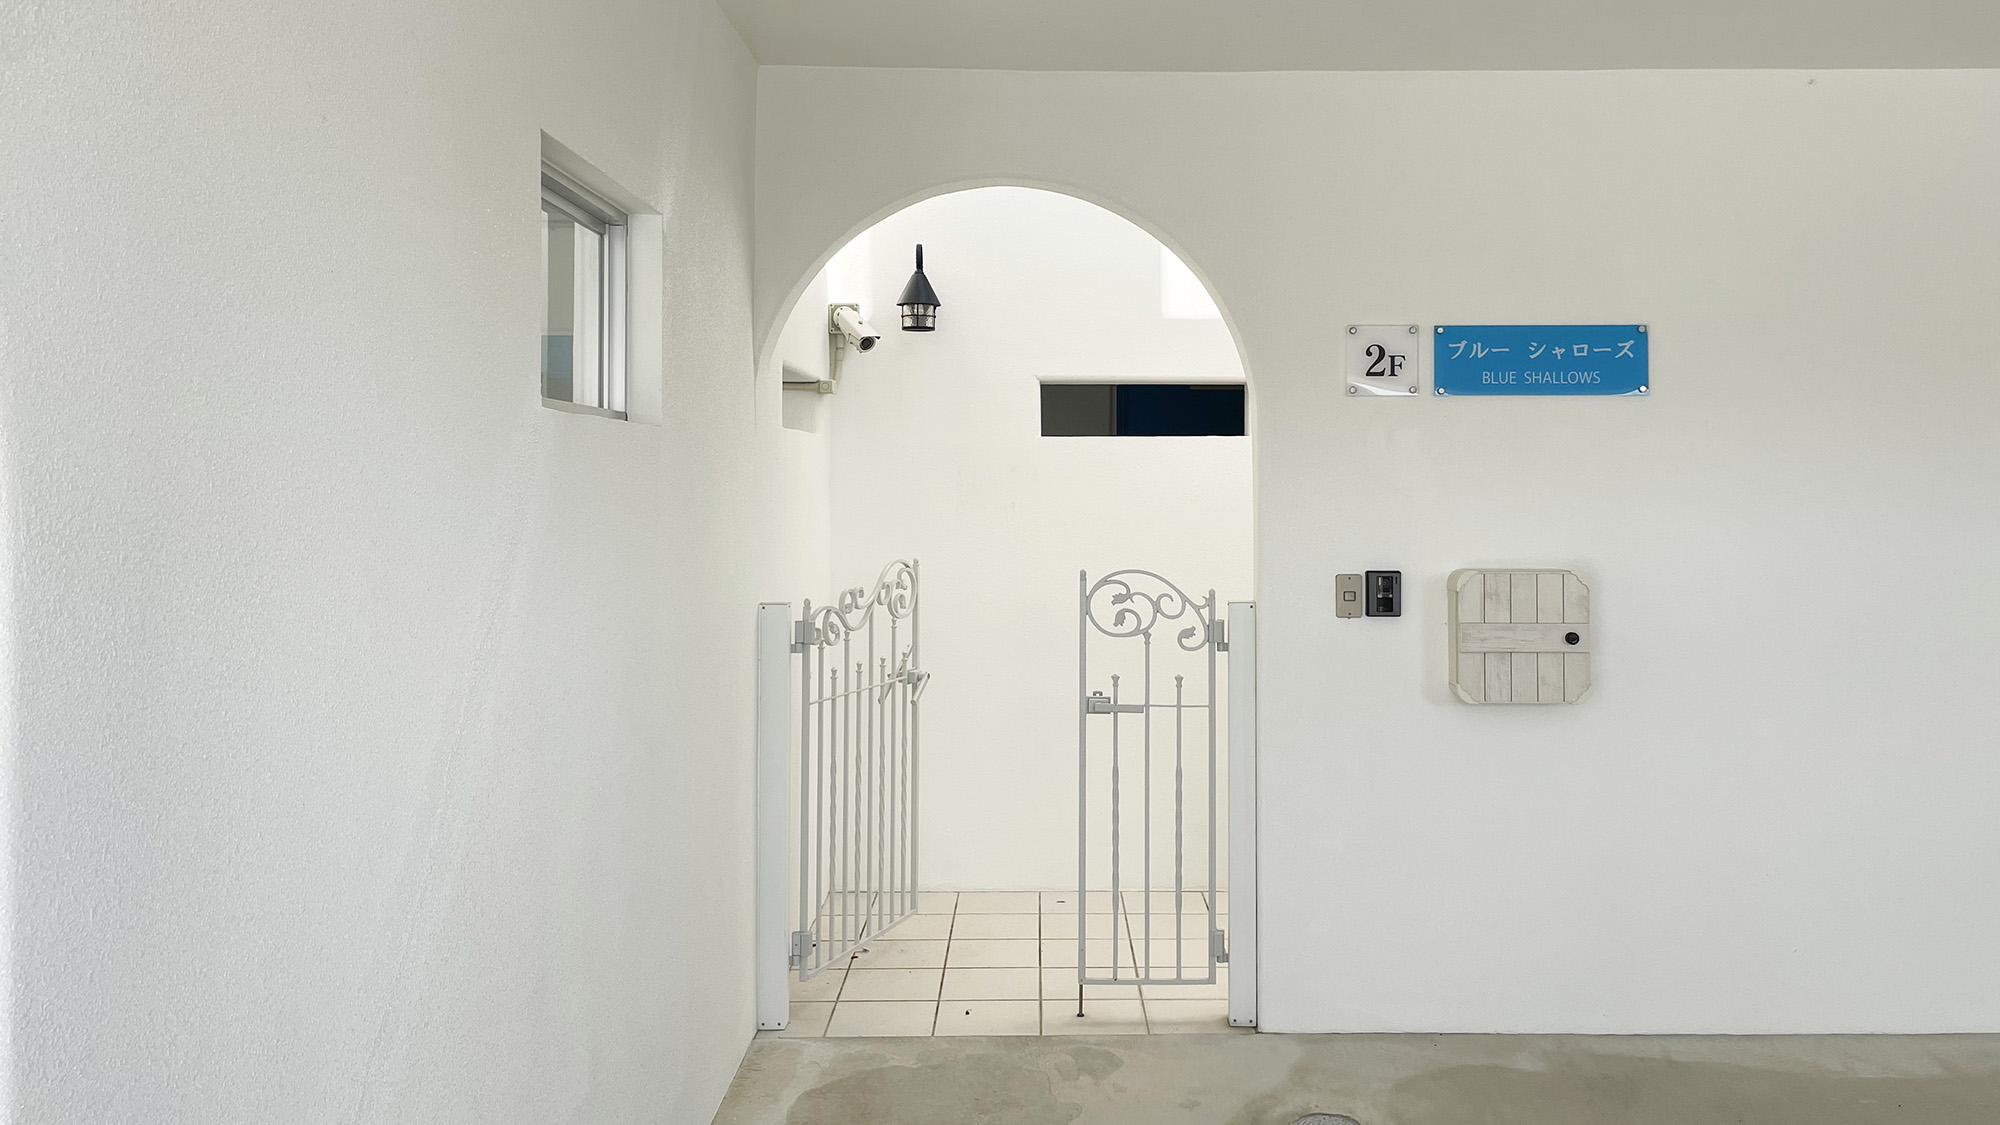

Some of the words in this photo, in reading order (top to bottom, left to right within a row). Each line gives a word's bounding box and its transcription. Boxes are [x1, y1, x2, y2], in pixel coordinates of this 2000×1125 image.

[1365, 343, 1406, 377] 2F
[1448, 340, 1509, 359] ブルー
[1528, 340, 1634, 360] シャローズ
[1482, 371, 1517, 384] BLUE
[1524, 371, 1601, 384] SHALLOWS
